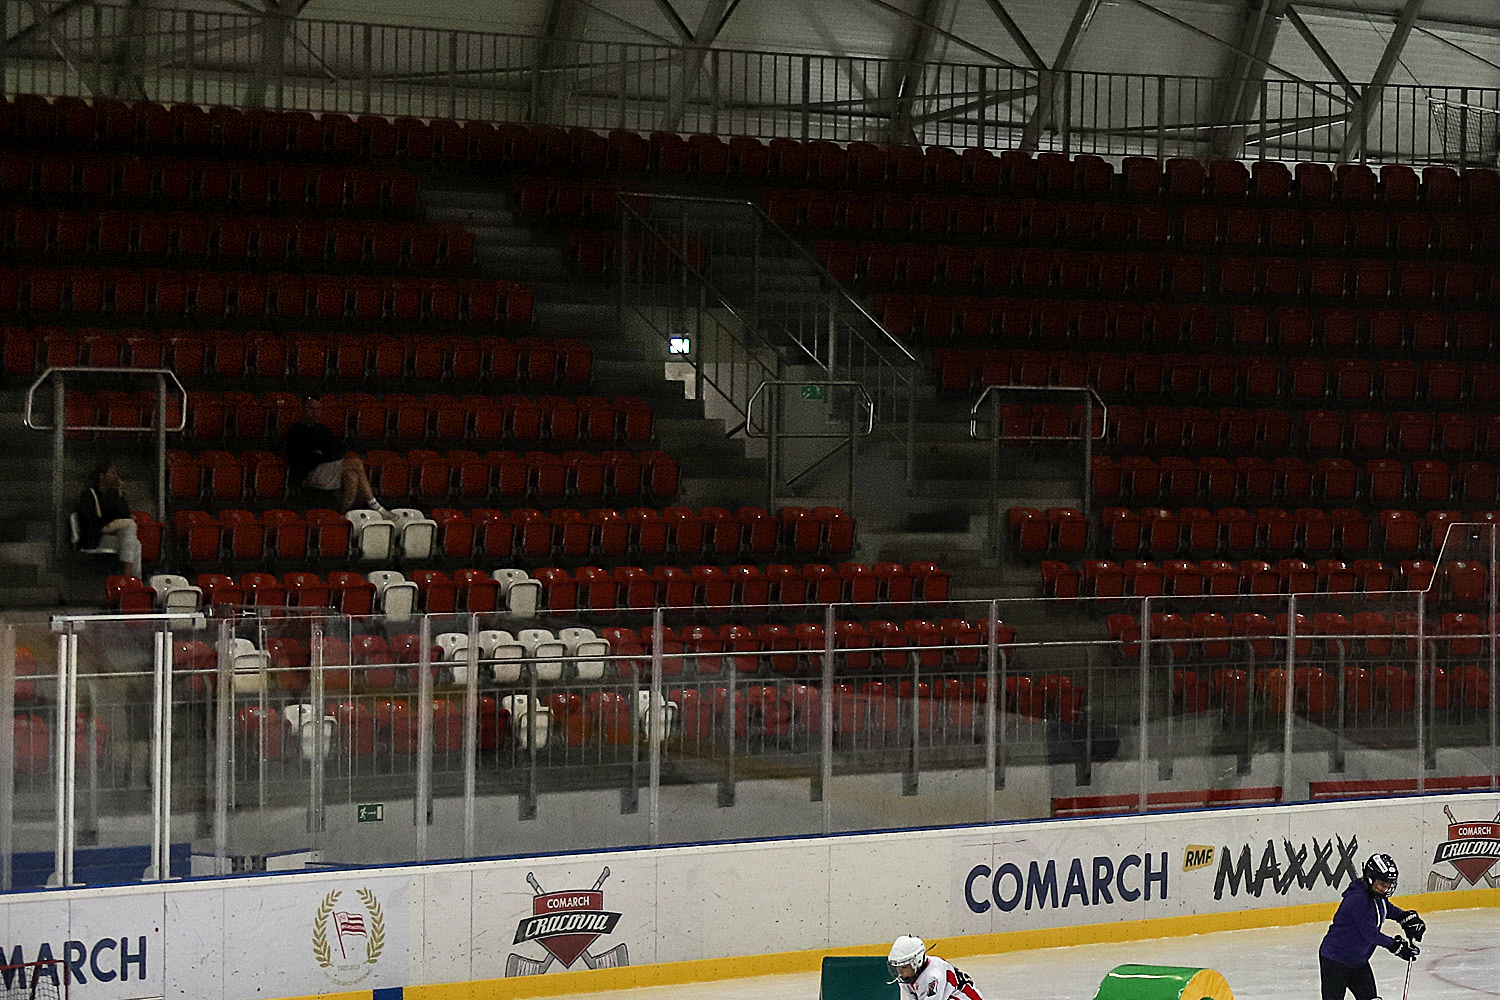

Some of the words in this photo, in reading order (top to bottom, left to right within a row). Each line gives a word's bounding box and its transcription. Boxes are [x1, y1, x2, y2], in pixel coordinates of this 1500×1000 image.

[1458, 827, 1492, 836] COMARCH
[1185, 849, 1213, 868] RMF
[1213, 833, 1358, 901] MAXXX
[964, 851, 1168, 914] COMARCH
[546, 896, 590, 909] COMARCH
